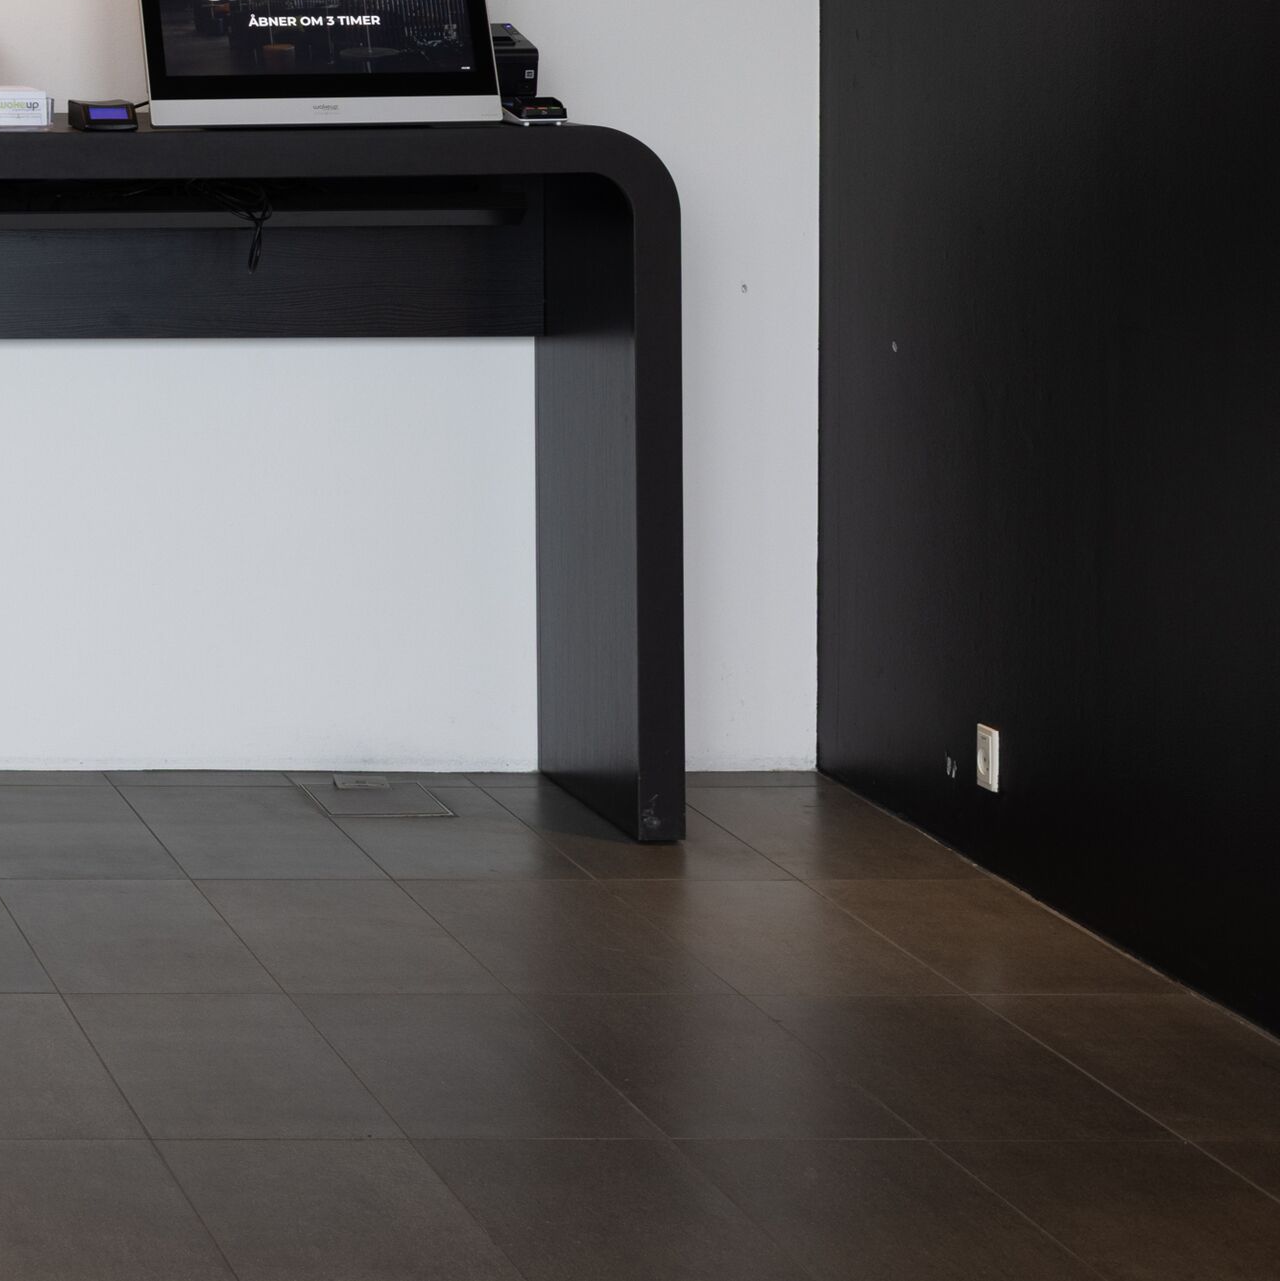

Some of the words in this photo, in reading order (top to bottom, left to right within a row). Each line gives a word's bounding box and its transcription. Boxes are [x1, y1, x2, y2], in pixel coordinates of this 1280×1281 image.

[248, 13, 297, 27] ÅBNER
[299, 15, 324, 27] OM
[325, 15, 335, 26] 3
[337, 15, 381, 26] TIMER
